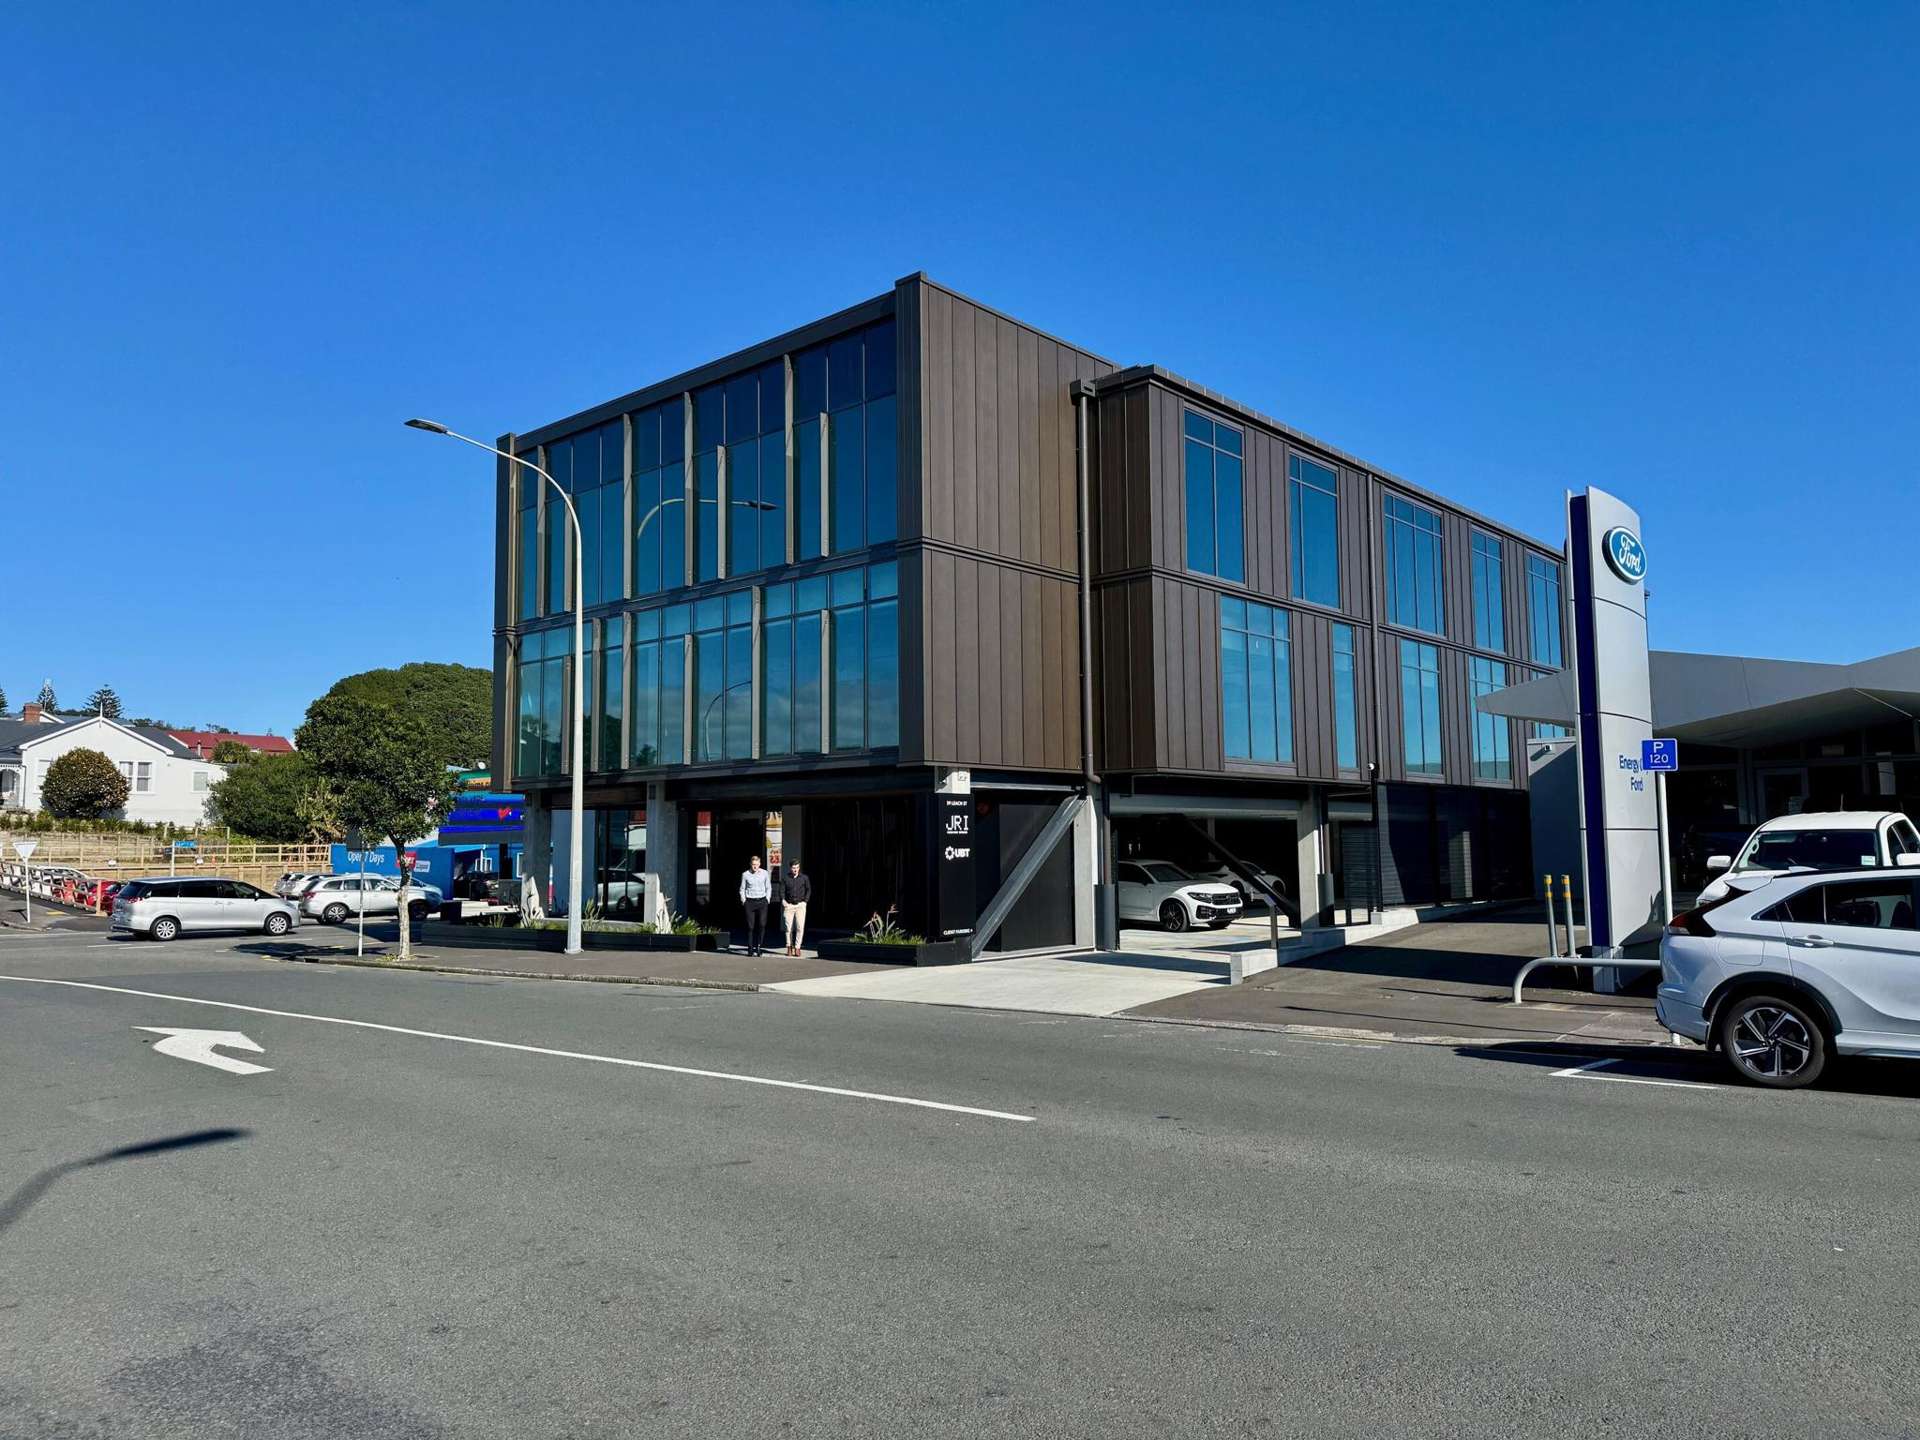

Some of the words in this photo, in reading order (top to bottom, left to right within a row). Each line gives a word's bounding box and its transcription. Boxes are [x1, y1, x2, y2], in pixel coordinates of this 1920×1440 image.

[1619, 534, 1641, 573] Ford
[1653, 741, 1664, 753] P
[1619, 754, 1639, 773] Energy
[1649, 754, 1669, 763] 120
[1631, 776, 1643, 791] Ford
[945, 815, 969, 831] JRI
[369, 851, 384, 866] Days
